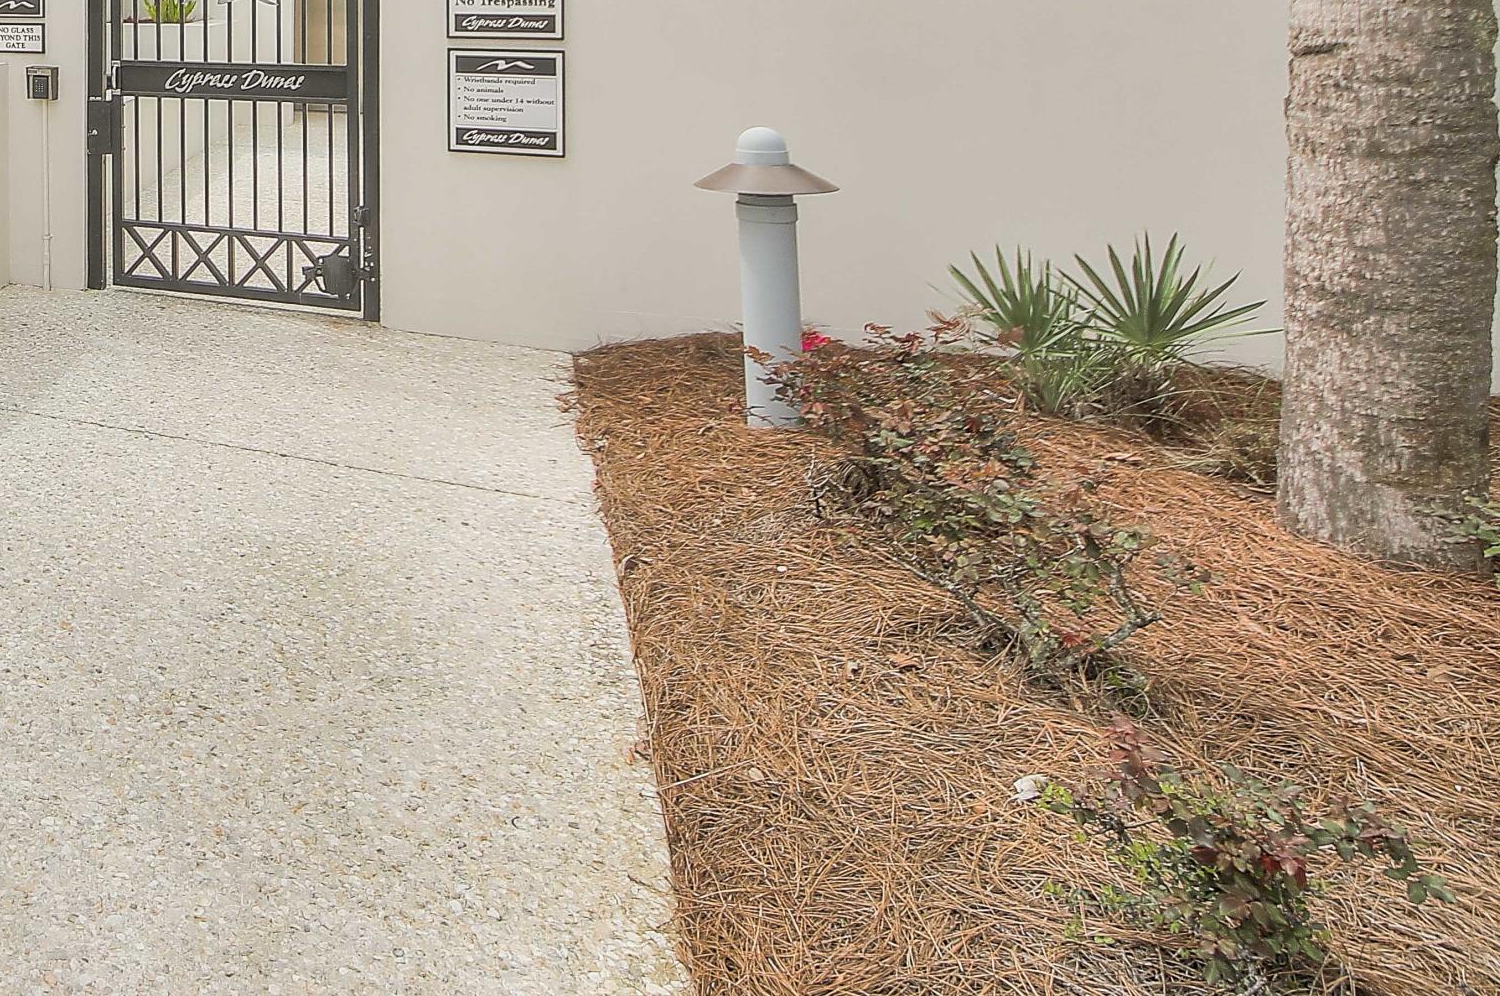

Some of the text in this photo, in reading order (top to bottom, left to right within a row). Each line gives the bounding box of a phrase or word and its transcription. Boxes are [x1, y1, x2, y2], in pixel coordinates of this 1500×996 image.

[462, 16, 548, 30] Cypress Dunes
[165, 68, 304, 93] Cypress Dunes
[463, 130, 550, 145] Cypress Dunes
